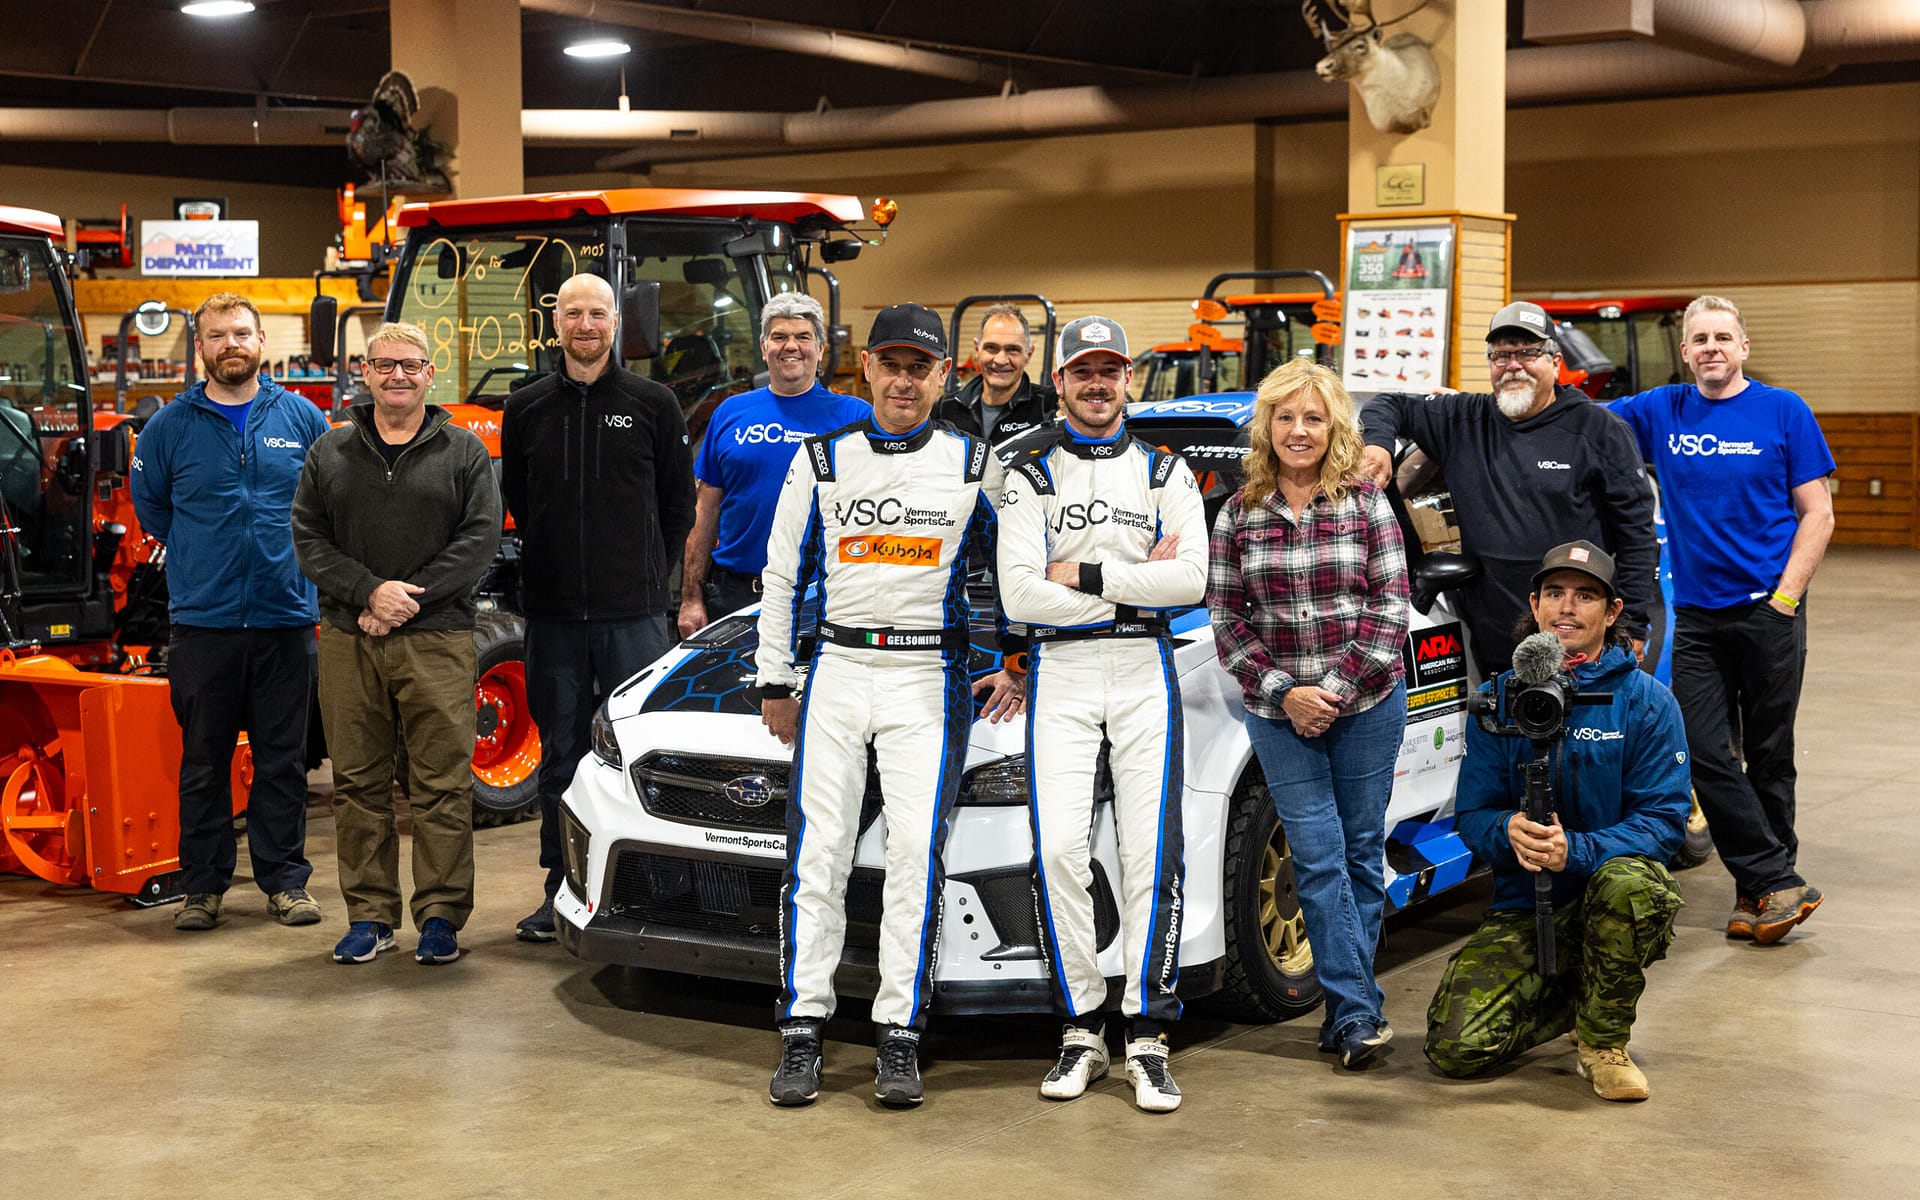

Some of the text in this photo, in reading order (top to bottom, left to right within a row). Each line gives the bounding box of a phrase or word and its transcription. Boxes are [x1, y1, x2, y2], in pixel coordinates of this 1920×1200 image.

[175, 243, 224, 255] PARTS
[145, 257, 254, 269] DEPARTMENT
[489, 255, 506, 269] for
[1359, 264, 1384, 275] 350
[914, 328, 939, 343] Kubota
[605, 414, 633, 428] VSC
[1000, 422, 1018, 432] VSC
[735, 423, 783, 445] VSC
[263, 436, 286, 448] VSC
[884, 441, 907, 450] VSC
[1668, 433, 1718, 456] VSC
[1718, 440, 1754, 449] Vermont
[1091, 446, 1113, 456] VSC
[1182, 445, 1253, 454] AMERIC
[1537, 460, 1558, 469] VSC
[834, 498, 902, 526] VSC
[905, 507, 948, 518] Vermont
[1111, 507, 1149, 522] Vermont
[904, 516, 956, 528] SportsCar
[873, 542, 933, 560] Kubota
[886, 634, 942, 646] GELSOMINO
[1573, 727, 1602, 741] VSC
[704, 831, 787, 851] VermontSportsCa
